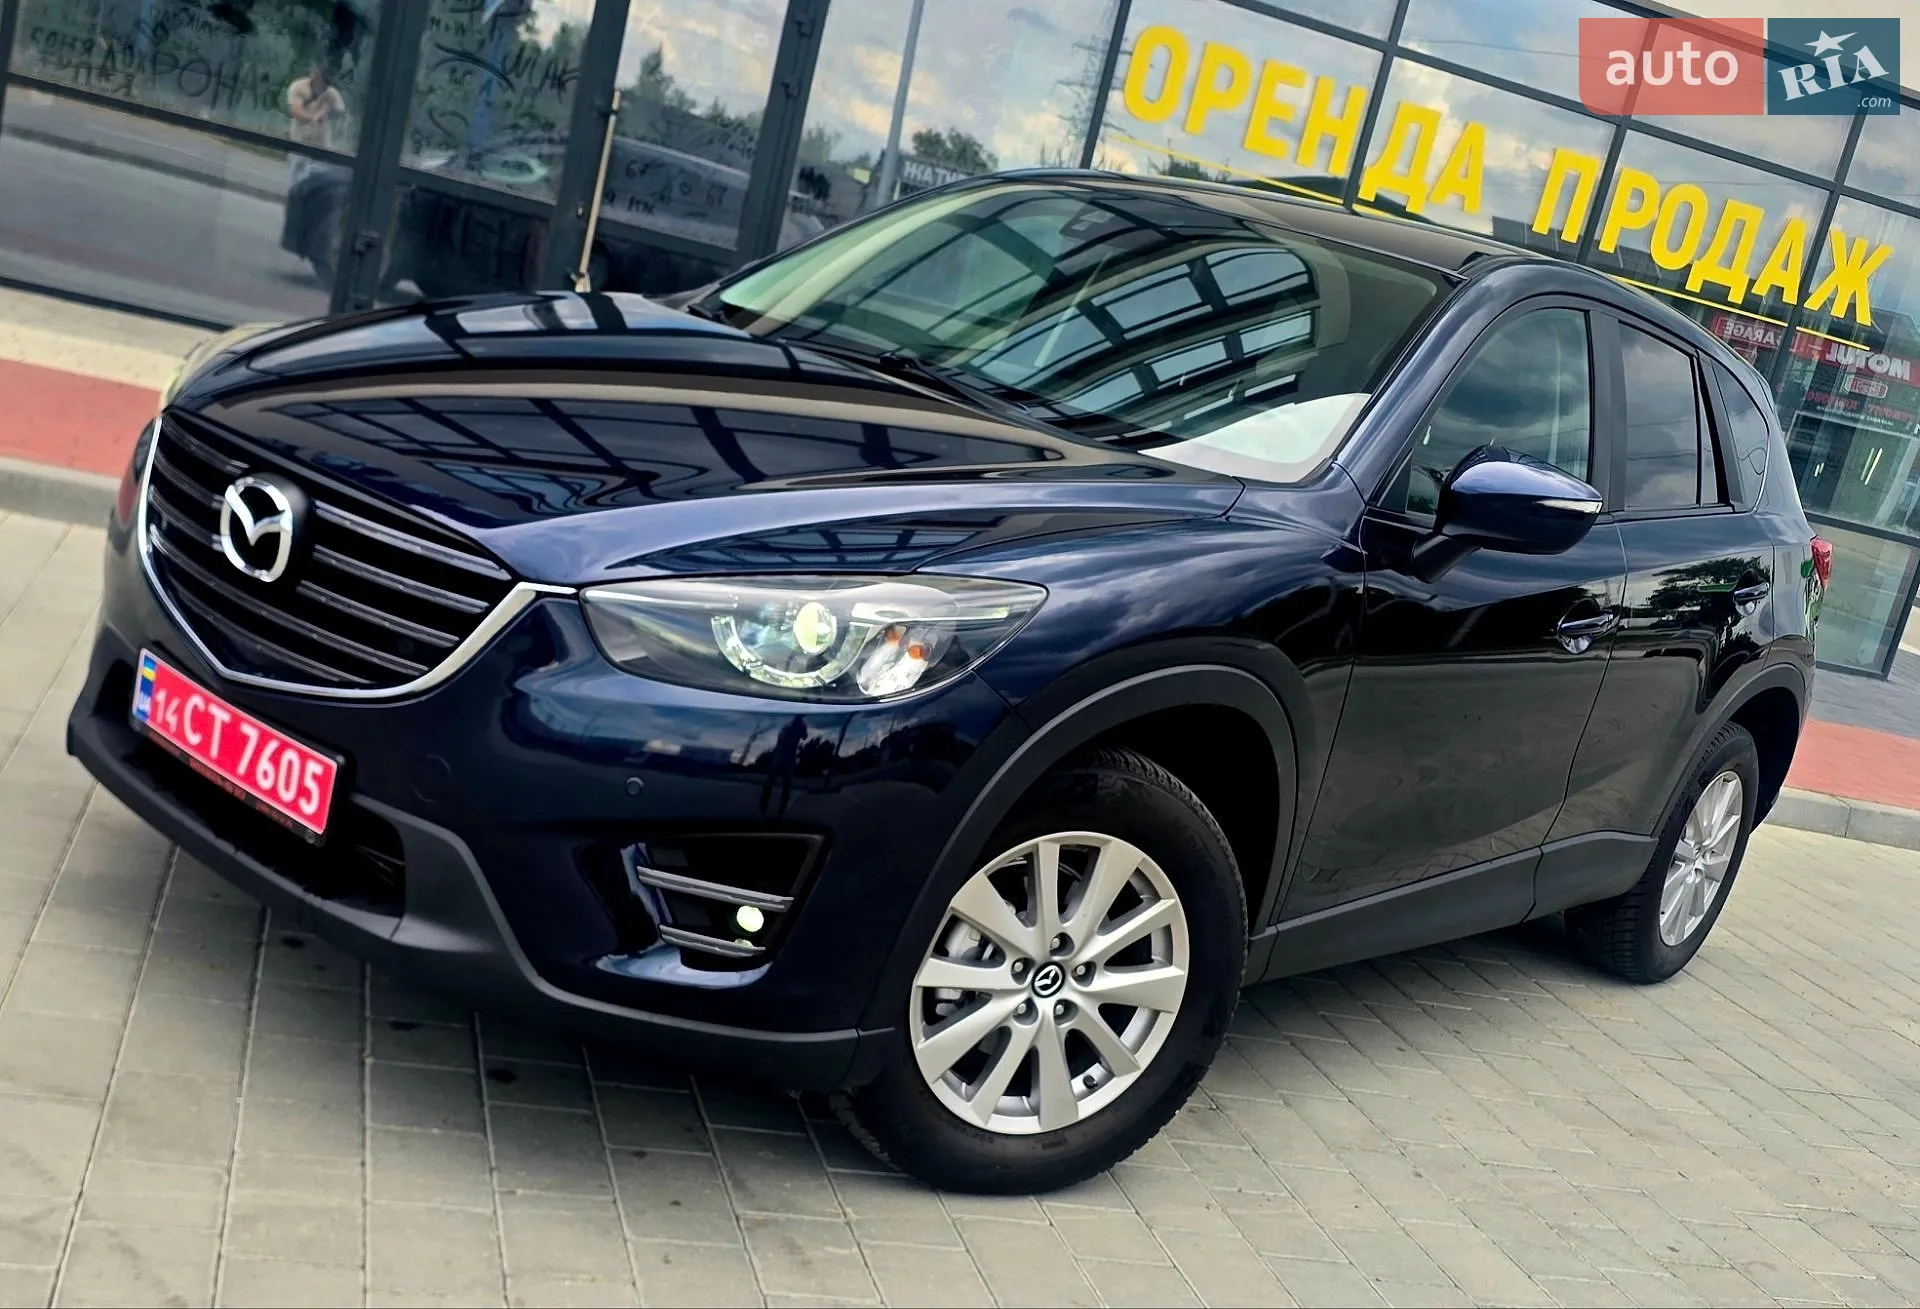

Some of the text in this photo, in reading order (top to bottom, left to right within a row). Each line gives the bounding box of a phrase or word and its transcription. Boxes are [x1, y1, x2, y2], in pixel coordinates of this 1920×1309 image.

[1124, 26, 1893, 325] ОРЕНДА ПРОДАЖ
[236, 723, 325, 816] 7605
